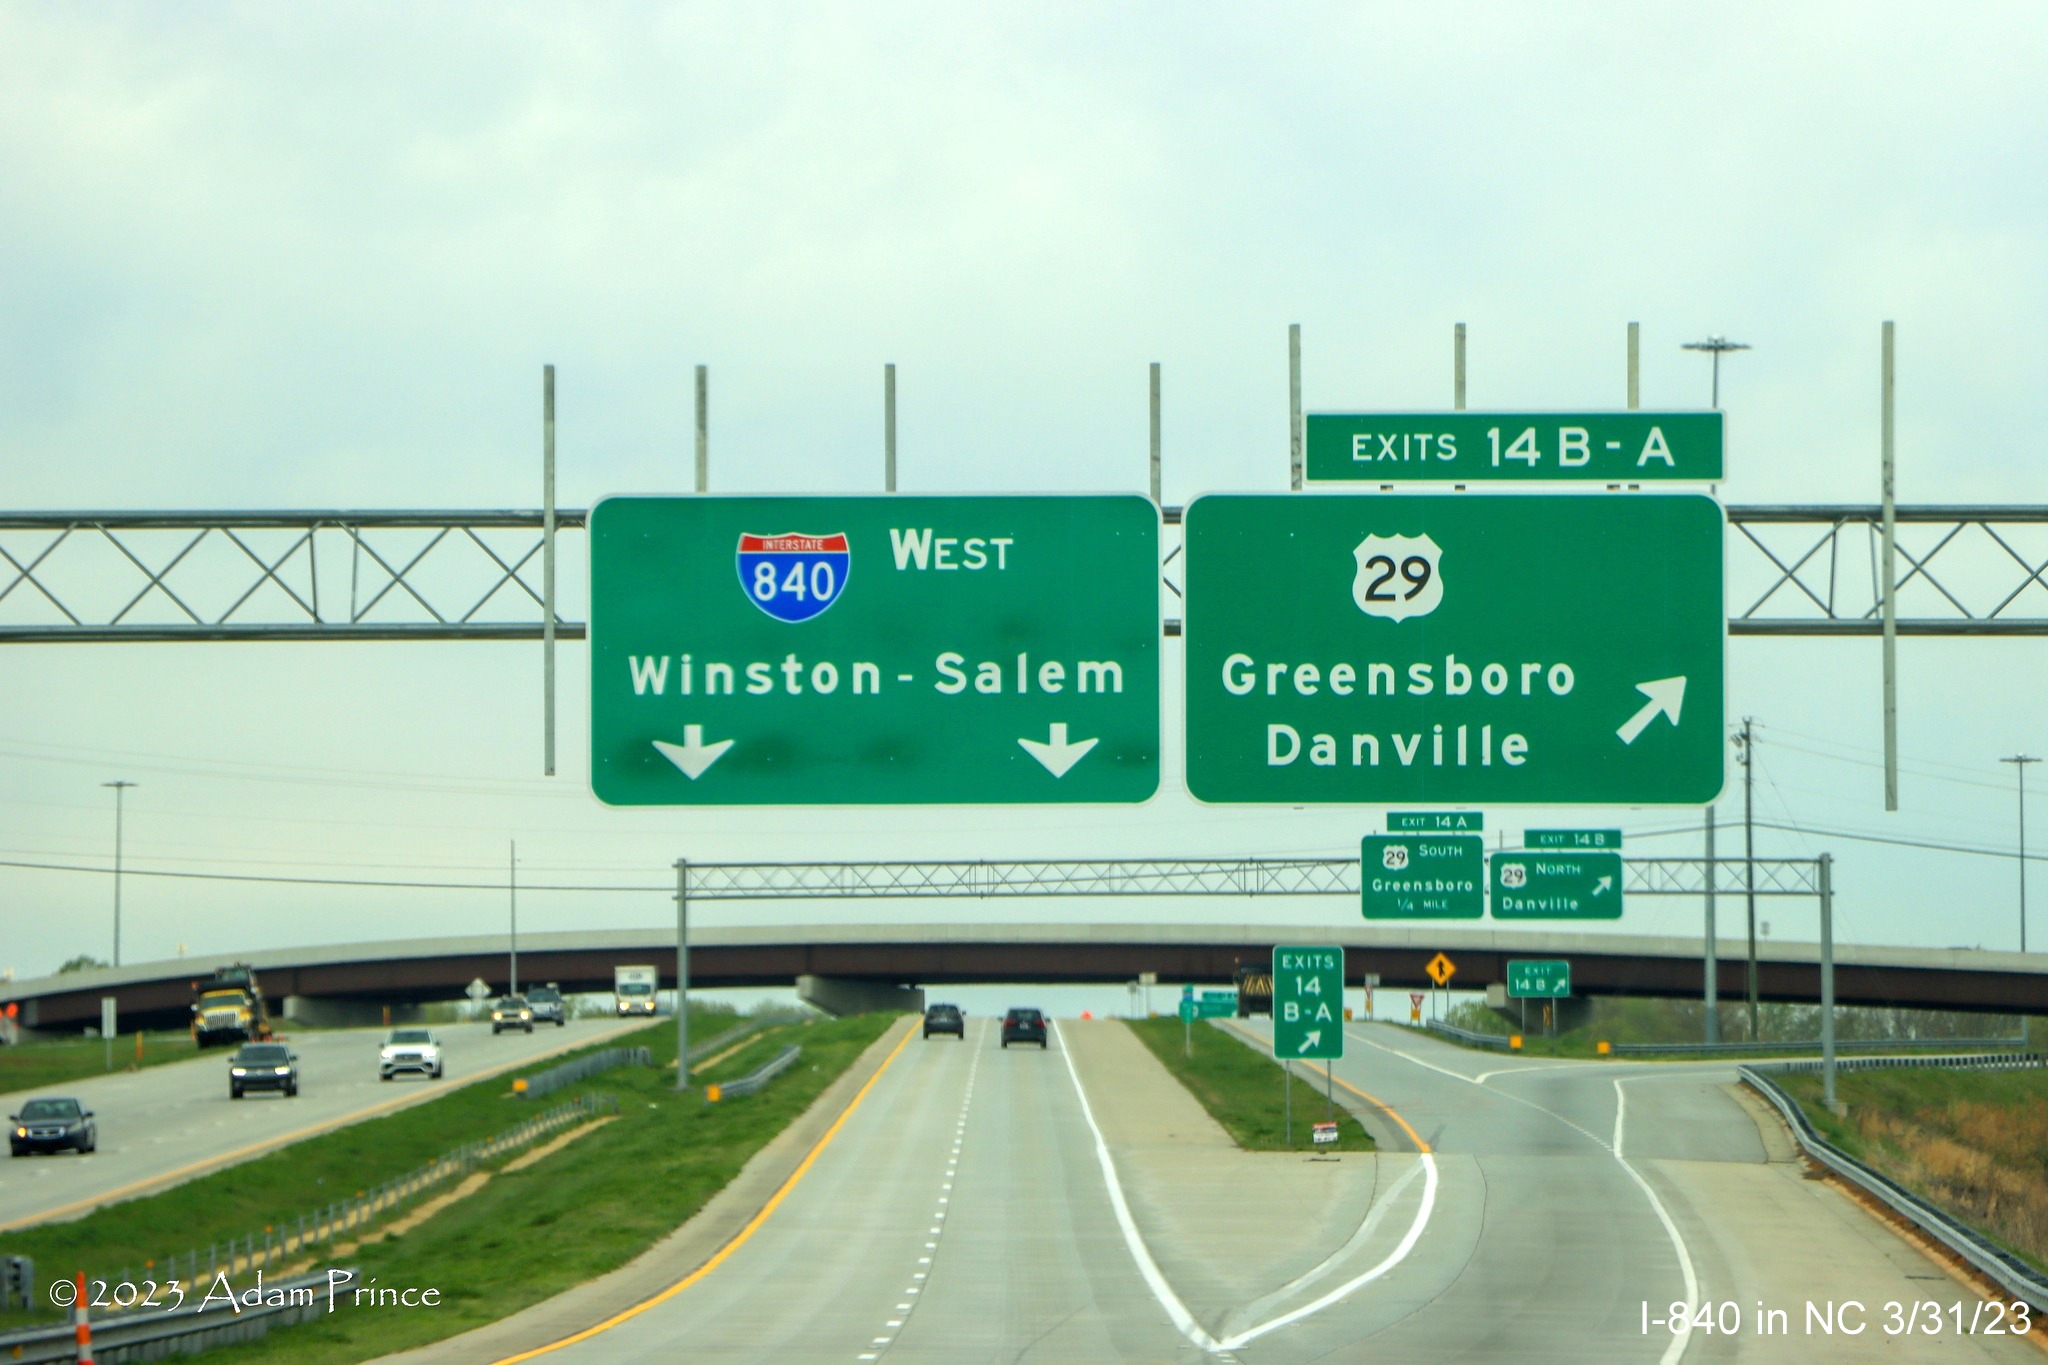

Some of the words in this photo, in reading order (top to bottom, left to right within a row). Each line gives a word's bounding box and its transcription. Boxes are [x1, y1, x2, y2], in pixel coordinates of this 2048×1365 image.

[1352, 433, 1457, 461] EXITS
[1487, 427, 1541, 466] 14
[762, 539, 824, 551] INTERSTATE
[889, 528, 1013, 570] WEST
[753, 561, 835, 601] 840
[1364, 556, 1432, 602] 29
[1222, 653, 1575, 695] Greensboro
[1267, 723, 1528, 766] Danville
[1401, 818, 1425, 827] EXIT
[1436, 816, 1451, 827] 14
[1456, 816, 1467, 827] A
[1540, 834, 1563, 844] EXIT
[1575, 834, 1589, 845] 14
[1594, 833, 1605, 845] B
[1419, 845, 1462, 856] SOUTH
[1386, 851, 1405, 865] 29
[1535, 862, 1580, 875] NORTH
[1503, 869, 1523, 884] 29
[1372, 879, 1473, 891] Greensboro
[1423, 900, 1447, 910] MILE
[1502, 897, 1578, 910] Danville
[1282, 955, 1334, 969] EXITS
[1524, 966, 1550, 976] EXIT
[1296, 976, 1321, 996] 14
[1515, 979, 1530, 991] 14
